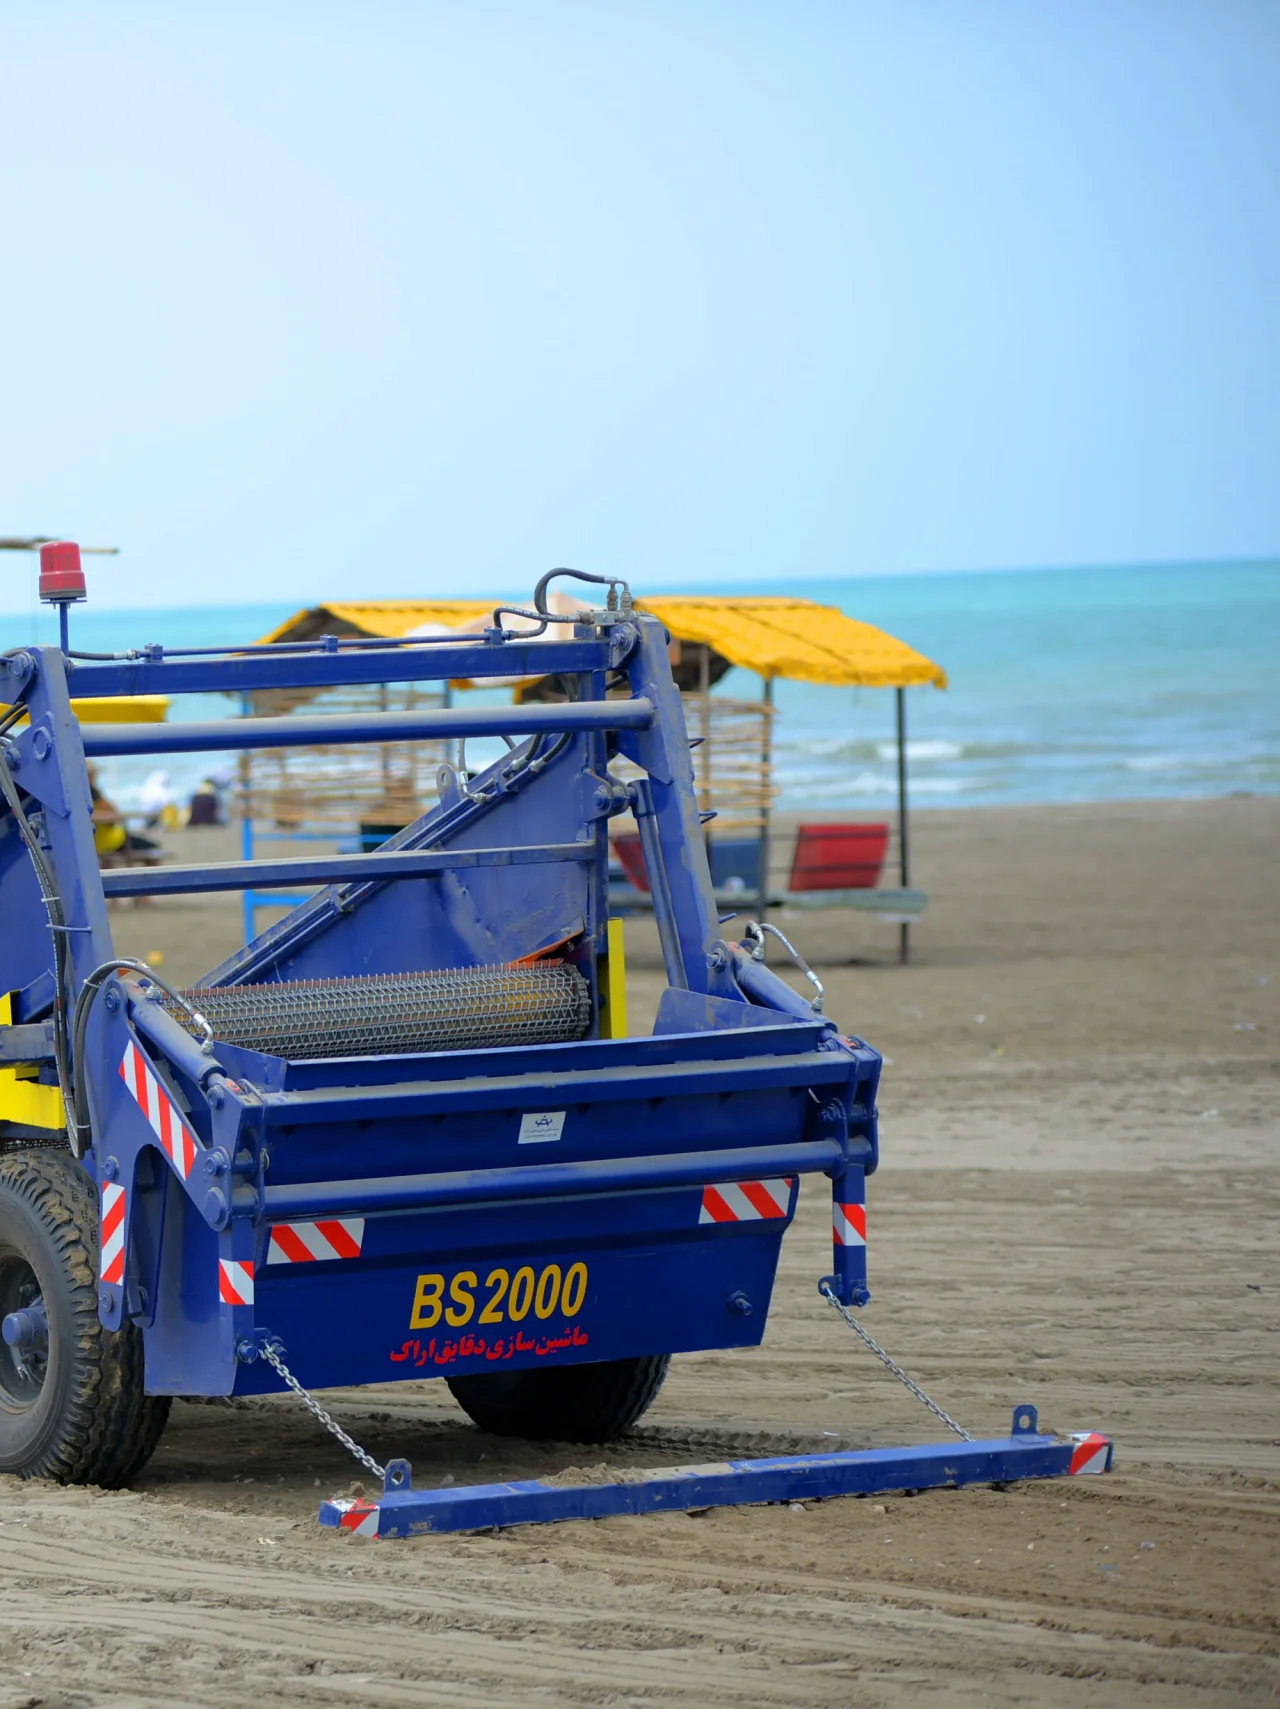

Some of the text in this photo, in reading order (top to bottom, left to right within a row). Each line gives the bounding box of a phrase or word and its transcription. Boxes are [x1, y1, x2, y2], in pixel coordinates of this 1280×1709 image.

[409, 1262, 588, 1330] BS2000
[389, 1326, 589, 1367] ماشین سازی دقایق اراک
